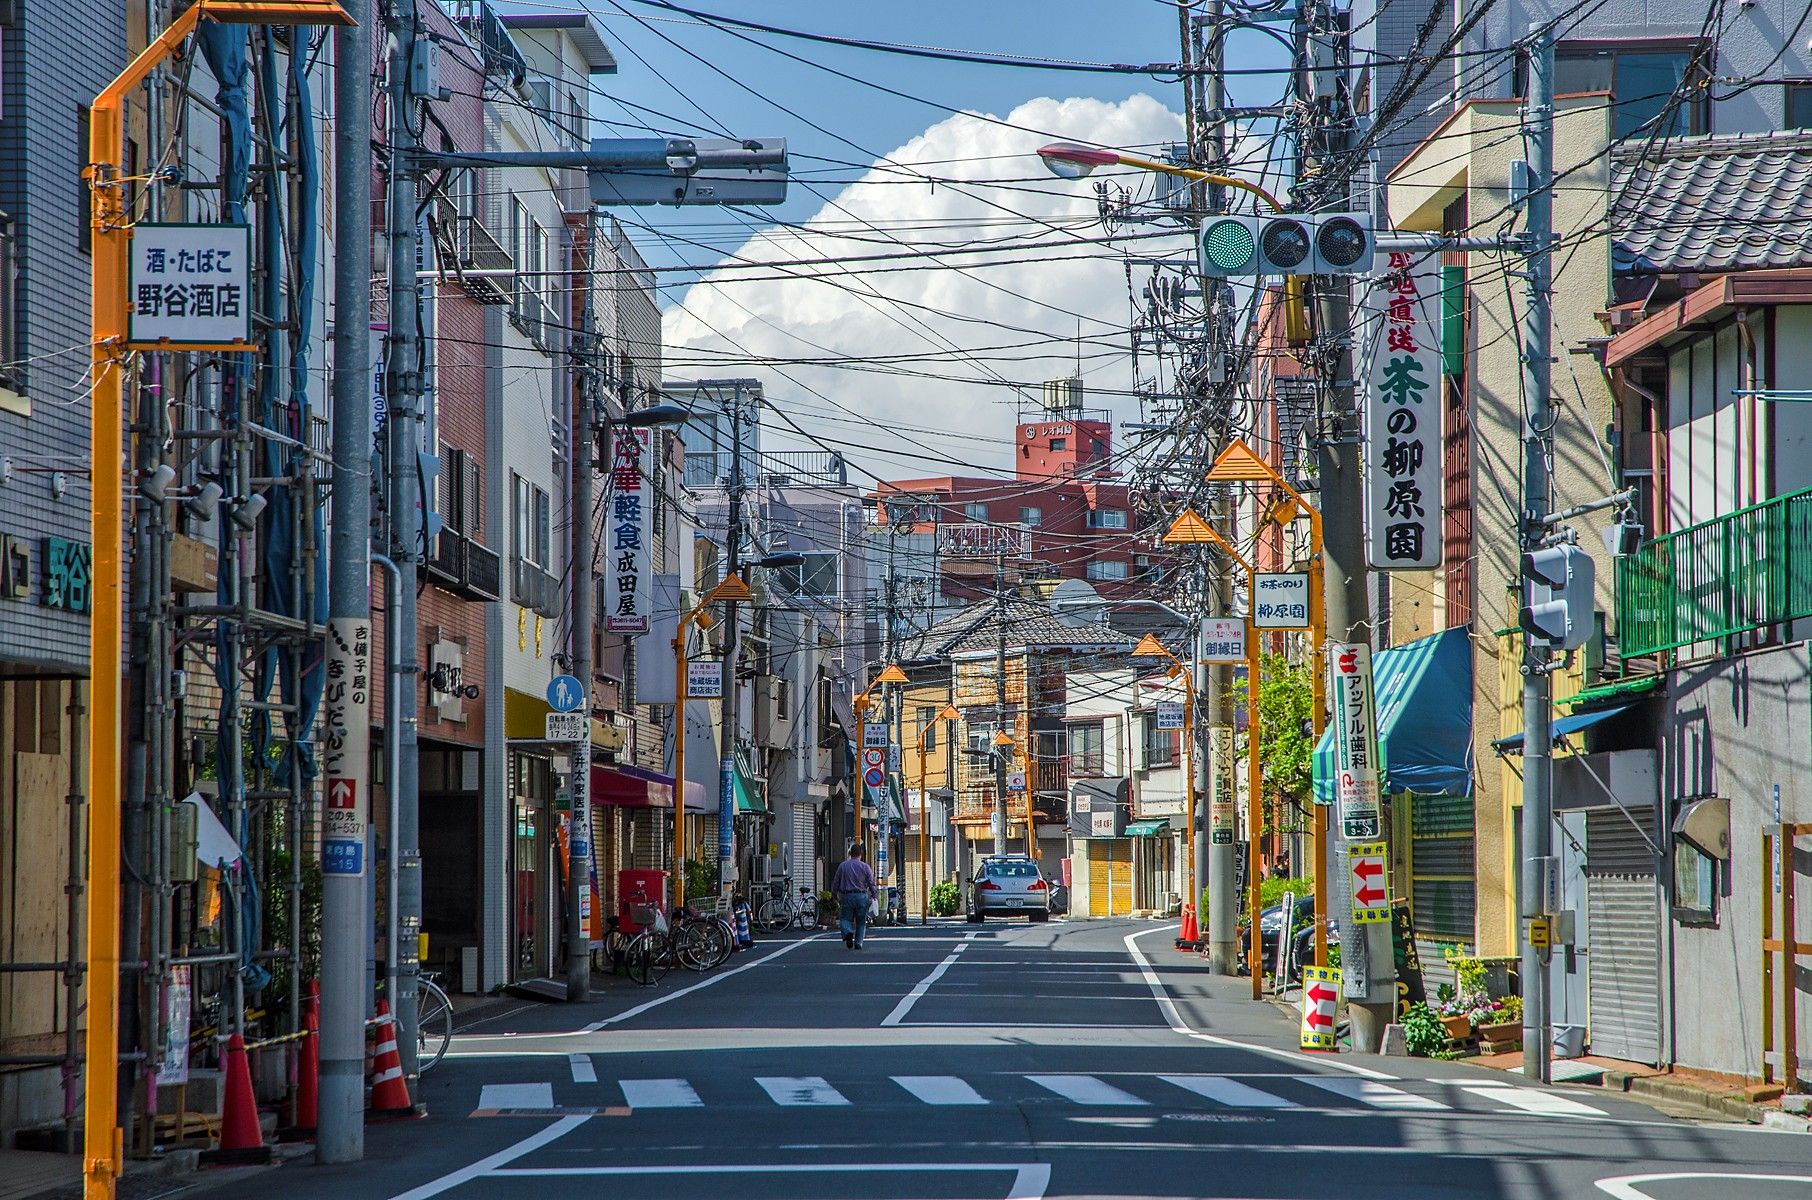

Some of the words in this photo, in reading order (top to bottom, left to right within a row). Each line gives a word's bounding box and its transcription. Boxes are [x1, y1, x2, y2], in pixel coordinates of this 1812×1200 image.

[146, 249, 233, 275] 酒・たばこ
[137, 283, 241, 319] 野谷酒店
[1377, 354, 1430, 561] 茶の柳原園
[1260, 579, 1303, 590] お茶とのり
[1258, 603, 1305, 619] 柳原園
[1205, 642, 1242, 656] 御縁日
[1347, 675, 1369, 770] アップル歯科
[551, 731, 578, 739] 17-22
[869, 752, 881, 762] 30
